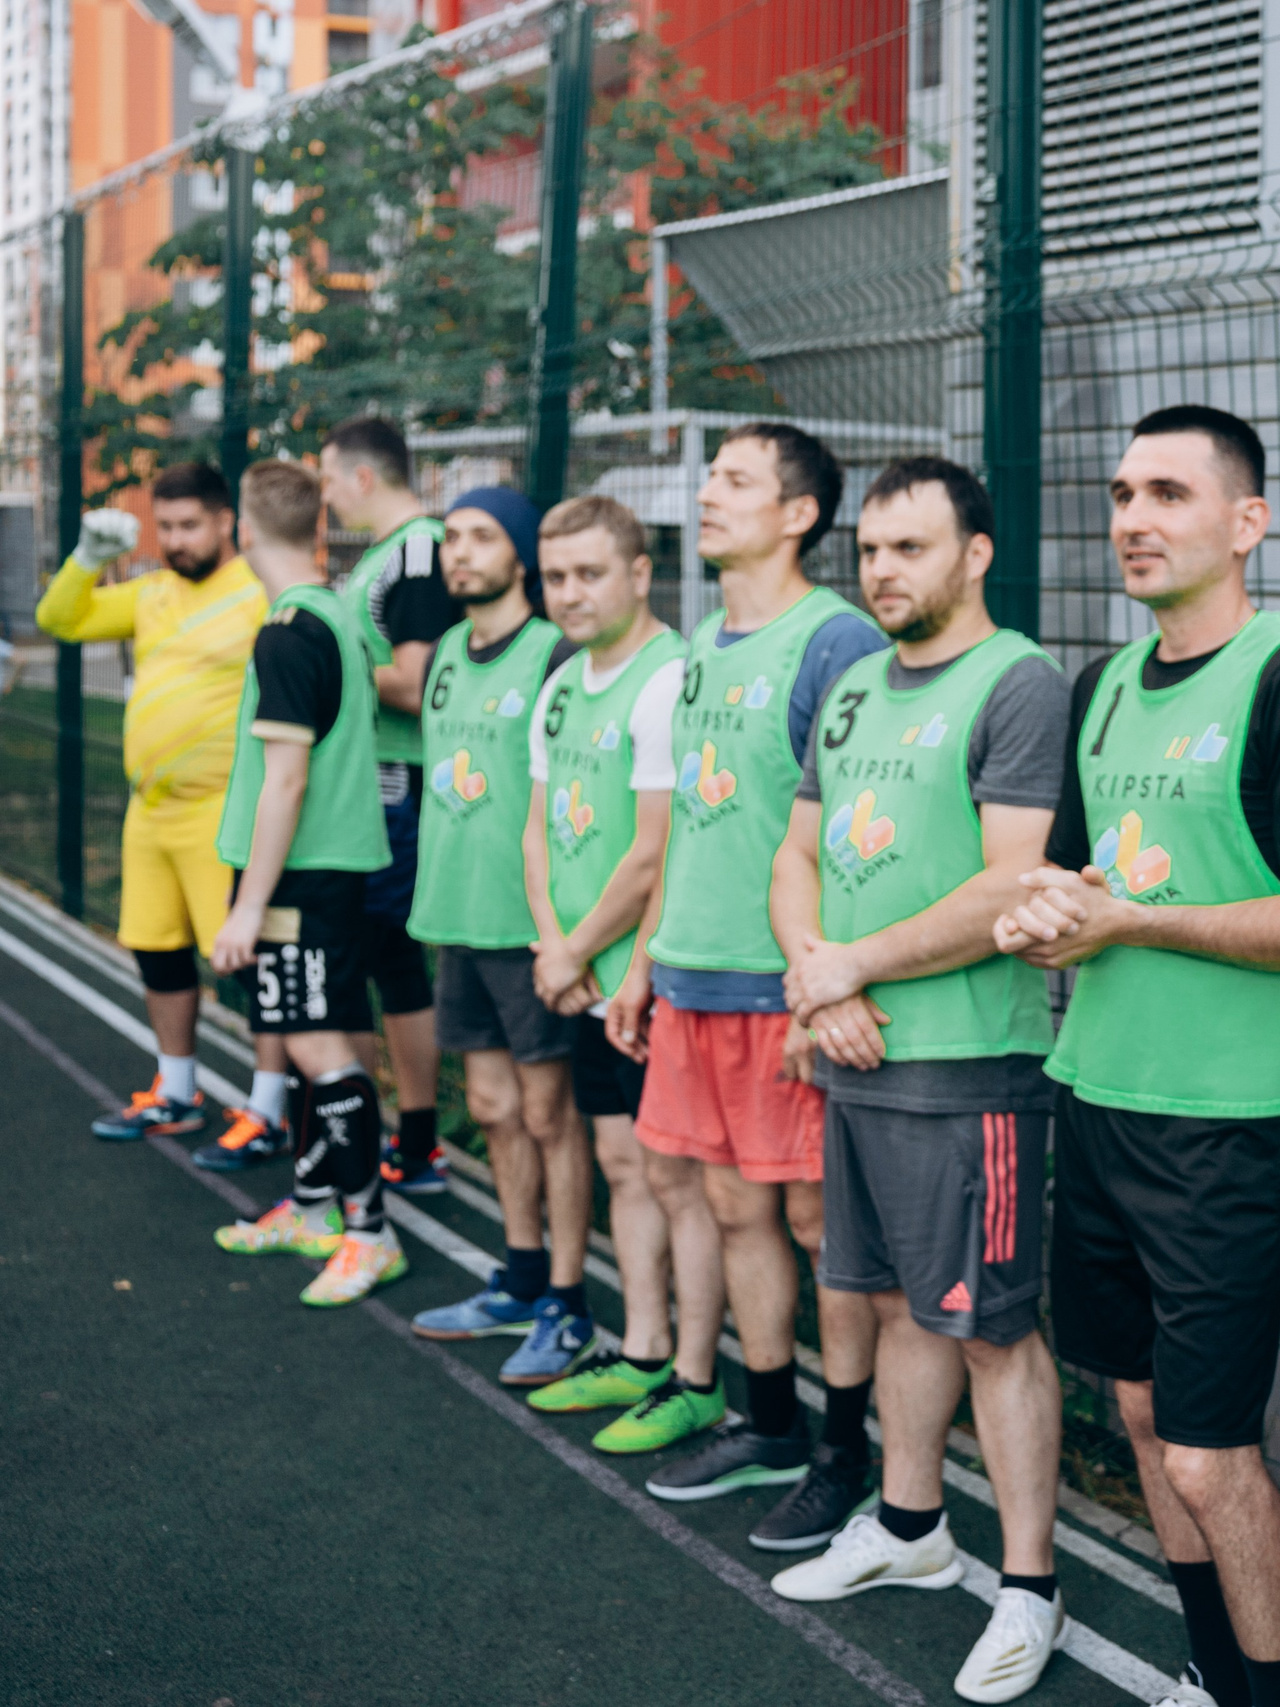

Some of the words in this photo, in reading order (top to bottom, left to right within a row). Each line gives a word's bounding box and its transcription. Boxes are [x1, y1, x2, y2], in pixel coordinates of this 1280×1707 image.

[431, 665, 454, 710] 6
[545, 688, 570, 738] 5
[824, 690, 869, 749] 3
[1090, 683, 1124, 756] 1
[837, 758, 915, 781] KIPSTA
[1092, 773, 1186, 800] KIPSTA
[1148, 886, 1182, 904] МА
[257, 952, 281, 1009] 5
